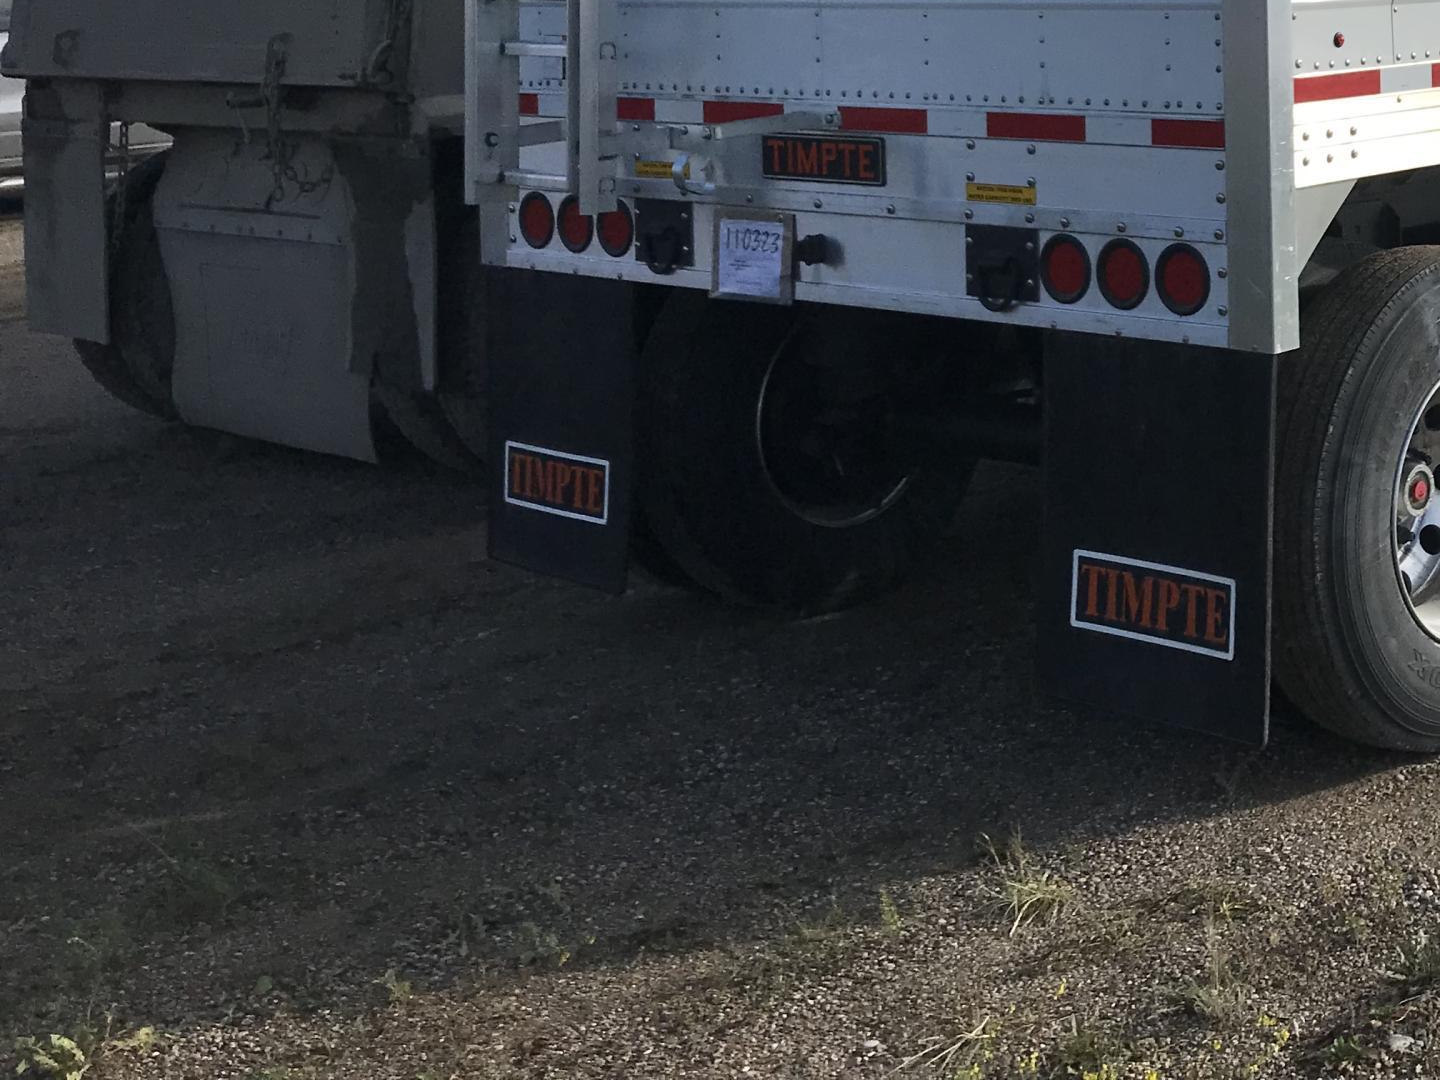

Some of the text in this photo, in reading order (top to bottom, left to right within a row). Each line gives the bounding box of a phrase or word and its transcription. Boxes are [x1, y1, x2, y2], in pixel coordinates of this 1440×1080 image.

[767, 139, 875, 179] TIMPTE
[511, 452, 604, 514] TIMPTE
[1081, 563, 1228, 644] TIMPTE
